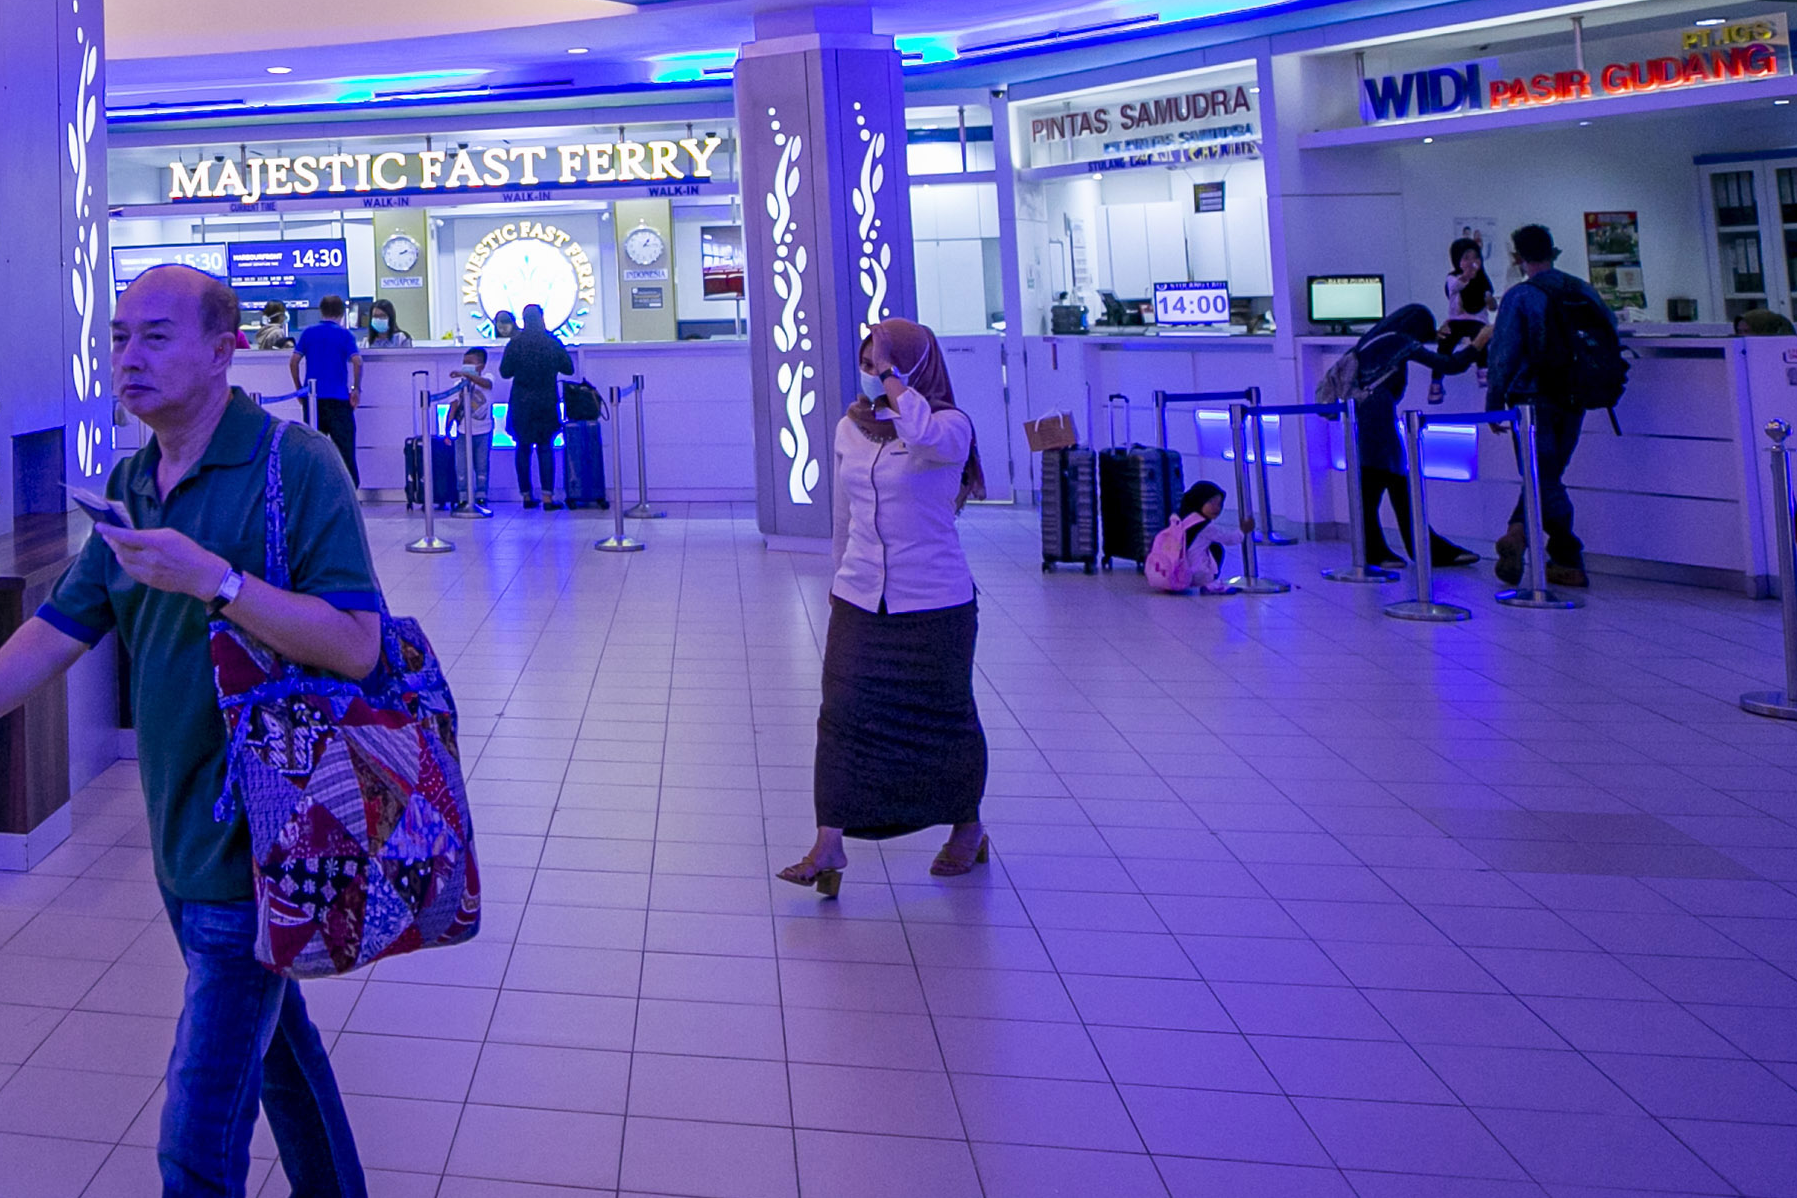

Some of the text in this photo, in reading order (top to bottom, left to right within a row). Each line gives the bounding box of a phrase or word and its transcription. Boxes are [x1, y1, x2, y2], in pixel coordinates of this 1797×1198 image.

[1364, 44, 1777, 122] WIDI PASIR GUDANG
[1032, 86, 1251, 143] PINTAS SAMUDRA
[168, 137, 722, 204] MAJESTIC FAST FERRY
[503, 191, 551, 202] WALK-IN
[648, 185, 699, 197] WALK-IN
[230, 201, 276, 213] CURRENT TIME
[363, 197, 409, 208] WALK-IN
[292, 248, 343, 268] 14:30
[462, 221, 596, 305] MAJESTIC FAST FERRY
[1158, 295, 1227, 315] 14:00
